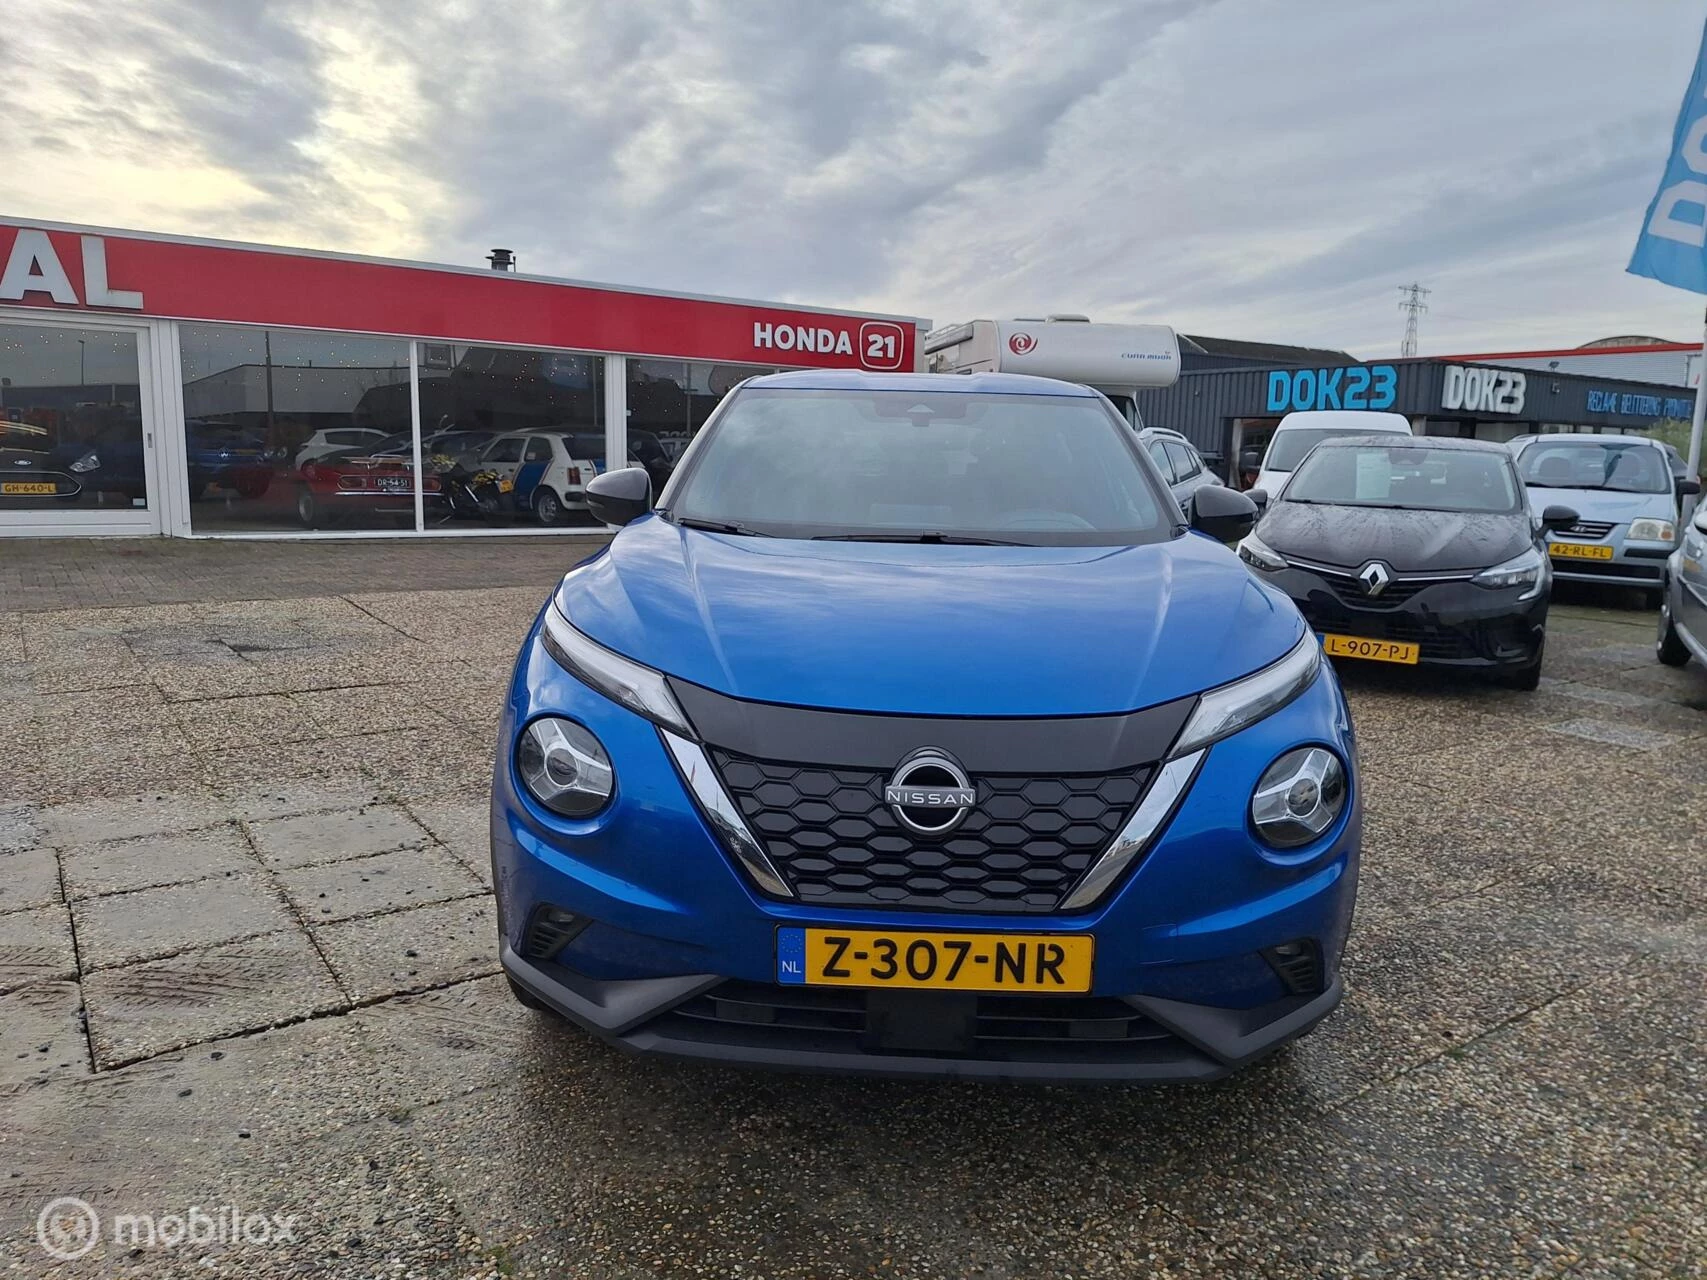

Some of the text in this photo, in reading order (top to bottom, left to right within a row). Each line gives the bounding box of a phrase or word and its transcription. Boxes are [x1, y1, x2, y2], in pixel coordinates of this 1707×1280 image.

[0, 228, 143, 309] AL
[754, 322, 895, 358] HONDA 21
[1266, 365, 1397, 412] DOK23
[1441, 365, 1527, 414] DOK23
[4, 483, 53, 493] GH-640-L
[1553, 545, 1607, 557] 42-RL-FL
[1330, 638, 1410, 660] L-907-PJ
[887, 790, 974, 805] NISSAN
[781, 960, 801, 974] NL
[822, 936, 1066, 985] Z-307-NR
